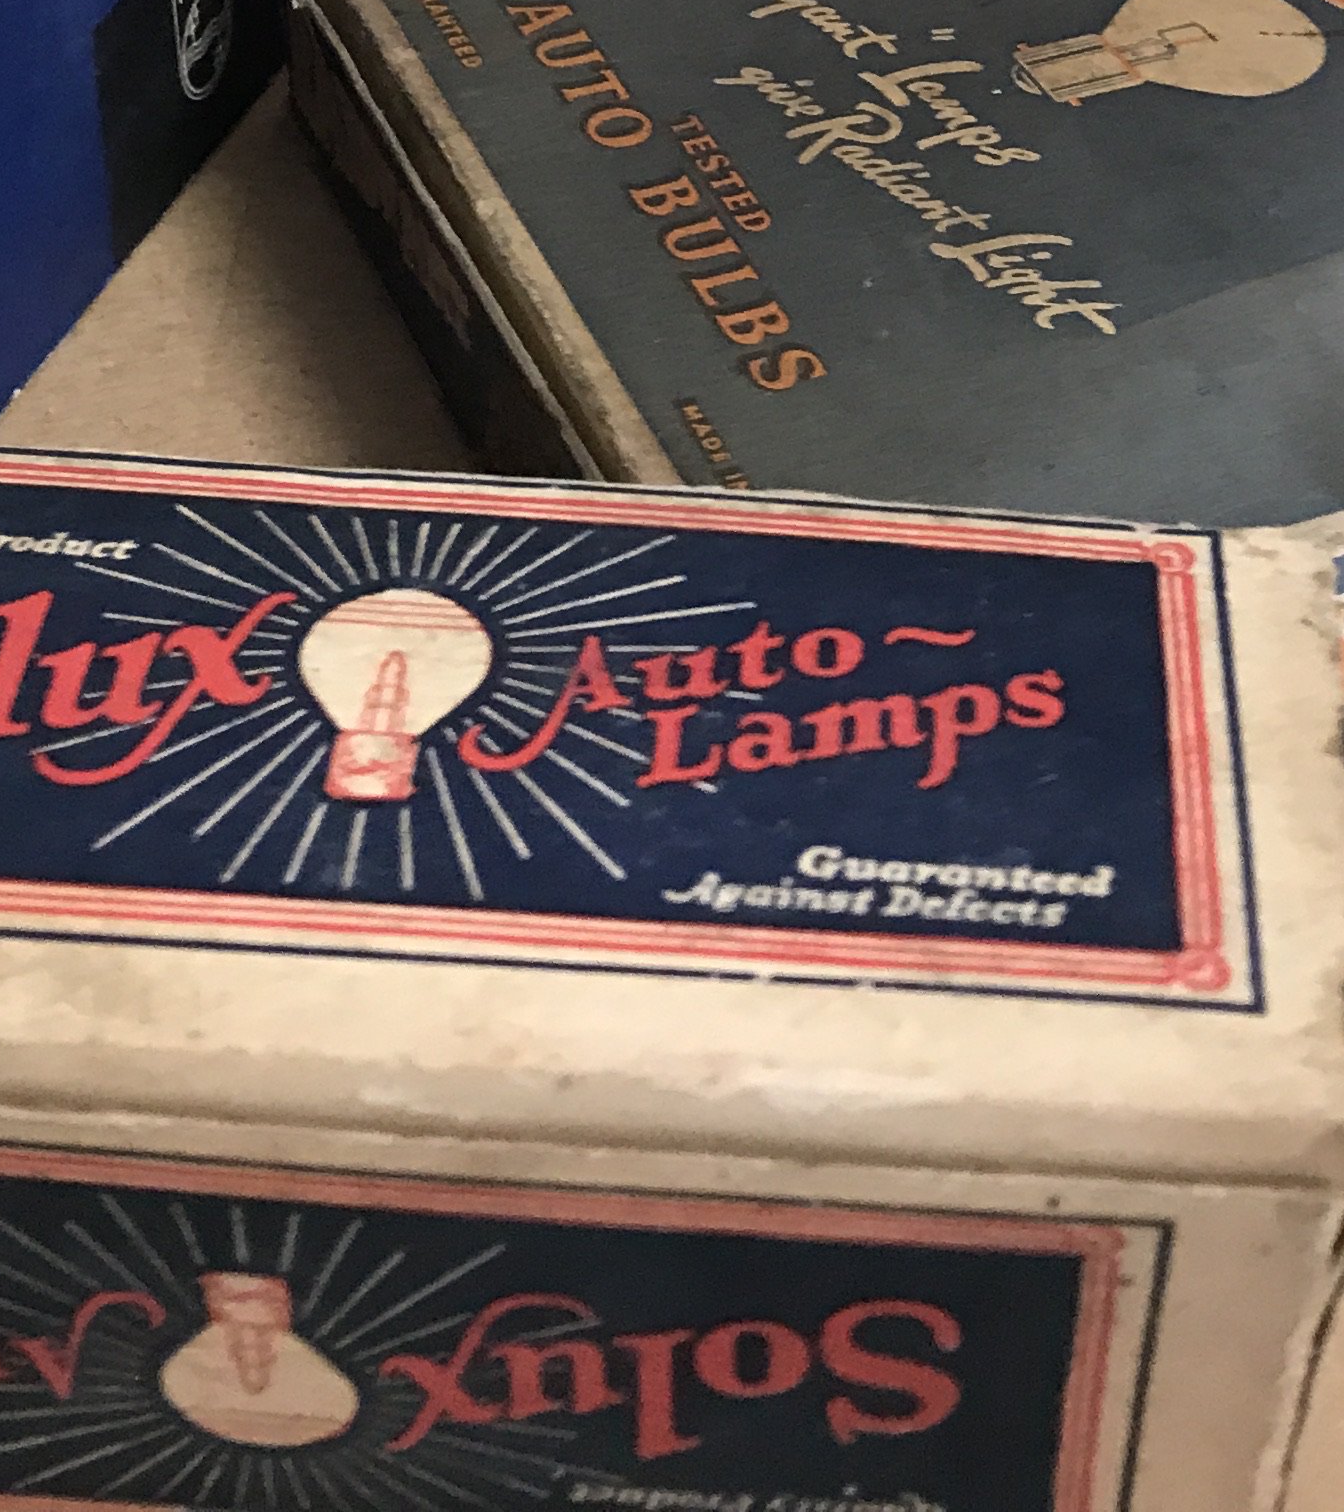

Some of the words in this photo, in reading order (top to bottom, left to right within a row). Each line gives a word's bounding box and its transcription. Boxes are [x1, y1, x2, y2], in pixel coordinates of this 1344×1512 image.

[858, 61, 1042, 166] Lamps
[505, 2, 653, 149] AUTO
[629, 175, 827, 391] BULBS
[670, 114, 772, 233] TESTED
[714, 66, 825, 117] give
[786, 101, 991, 233] Radiant
[929, 233, 1122, 334] Light
[637, 668, 1065, 788] Lamps
[660, 871, 876, 915] Against
[879, 884, 1069, 928] Defects
[796, 845, 1115, 897] Guaranteed
[379, 1293, 962, 1461] Solux
